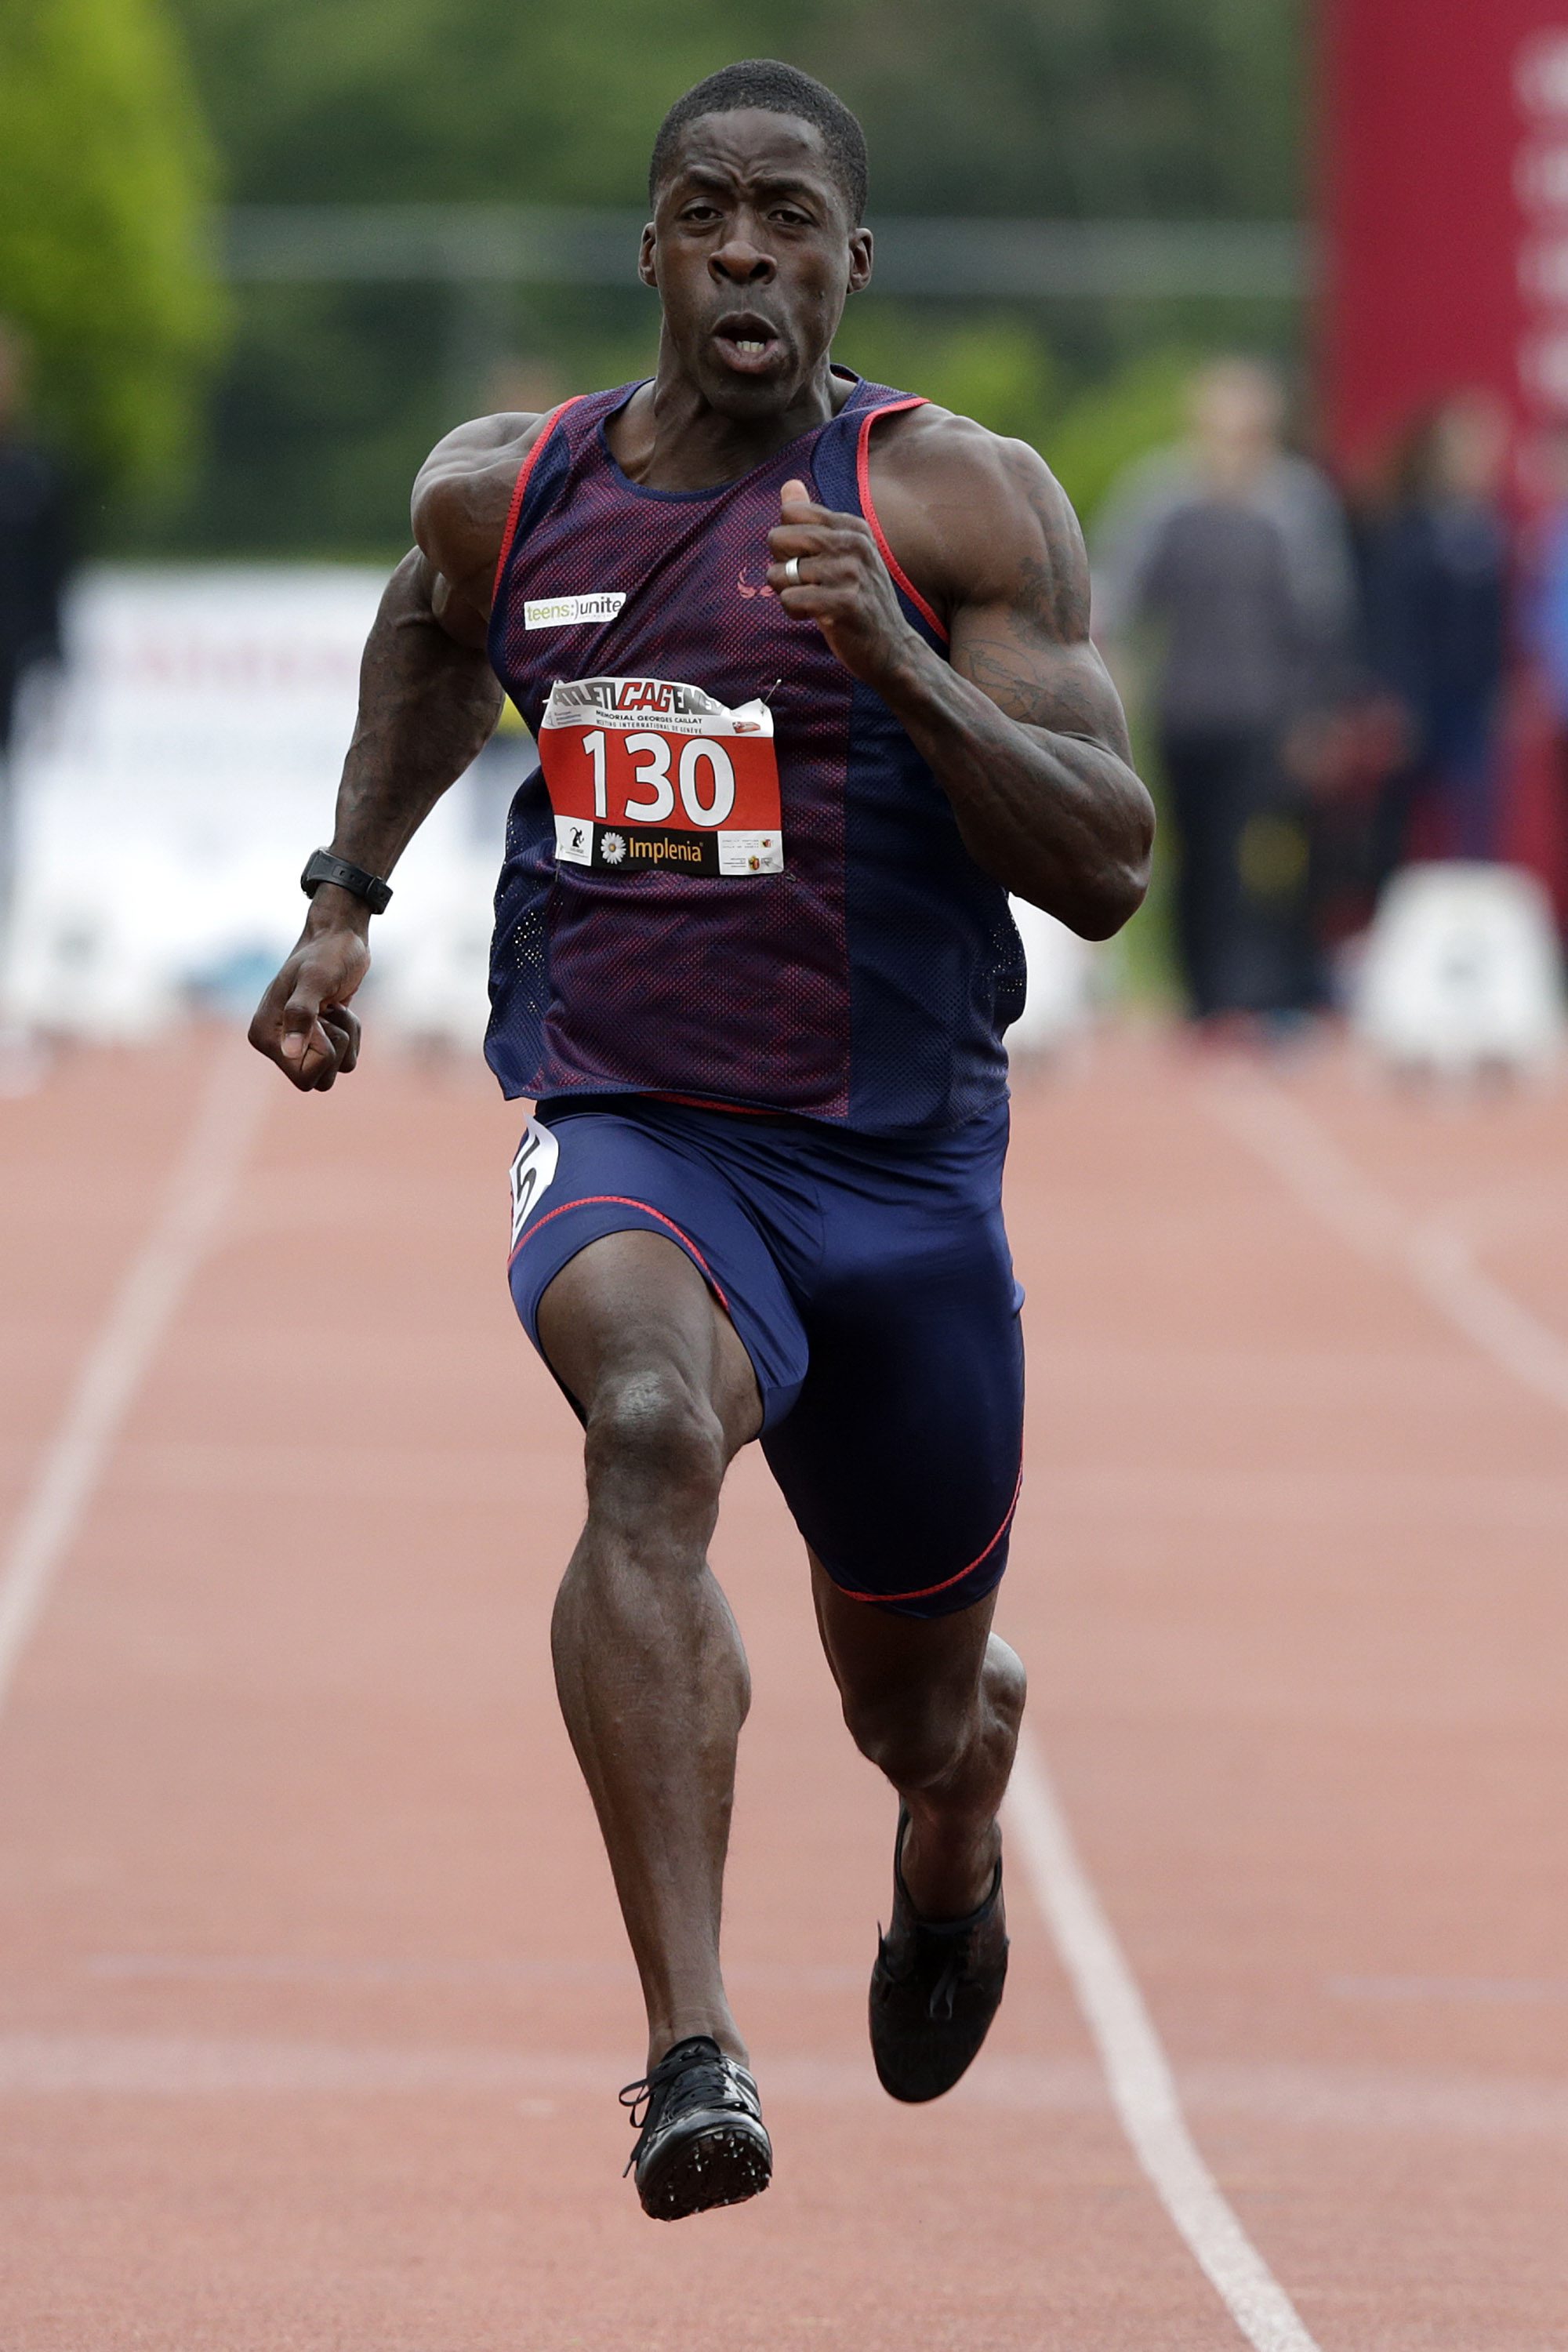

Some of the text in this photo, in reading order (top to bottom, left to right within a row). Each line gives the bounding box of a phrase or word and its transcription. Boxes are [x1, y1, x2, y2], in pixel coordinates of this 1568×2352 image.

[596, 710, 634, 720] MEMORIAL
[582, 729, 736, 827] 130
[630, 837, 701, 864] Implenia
